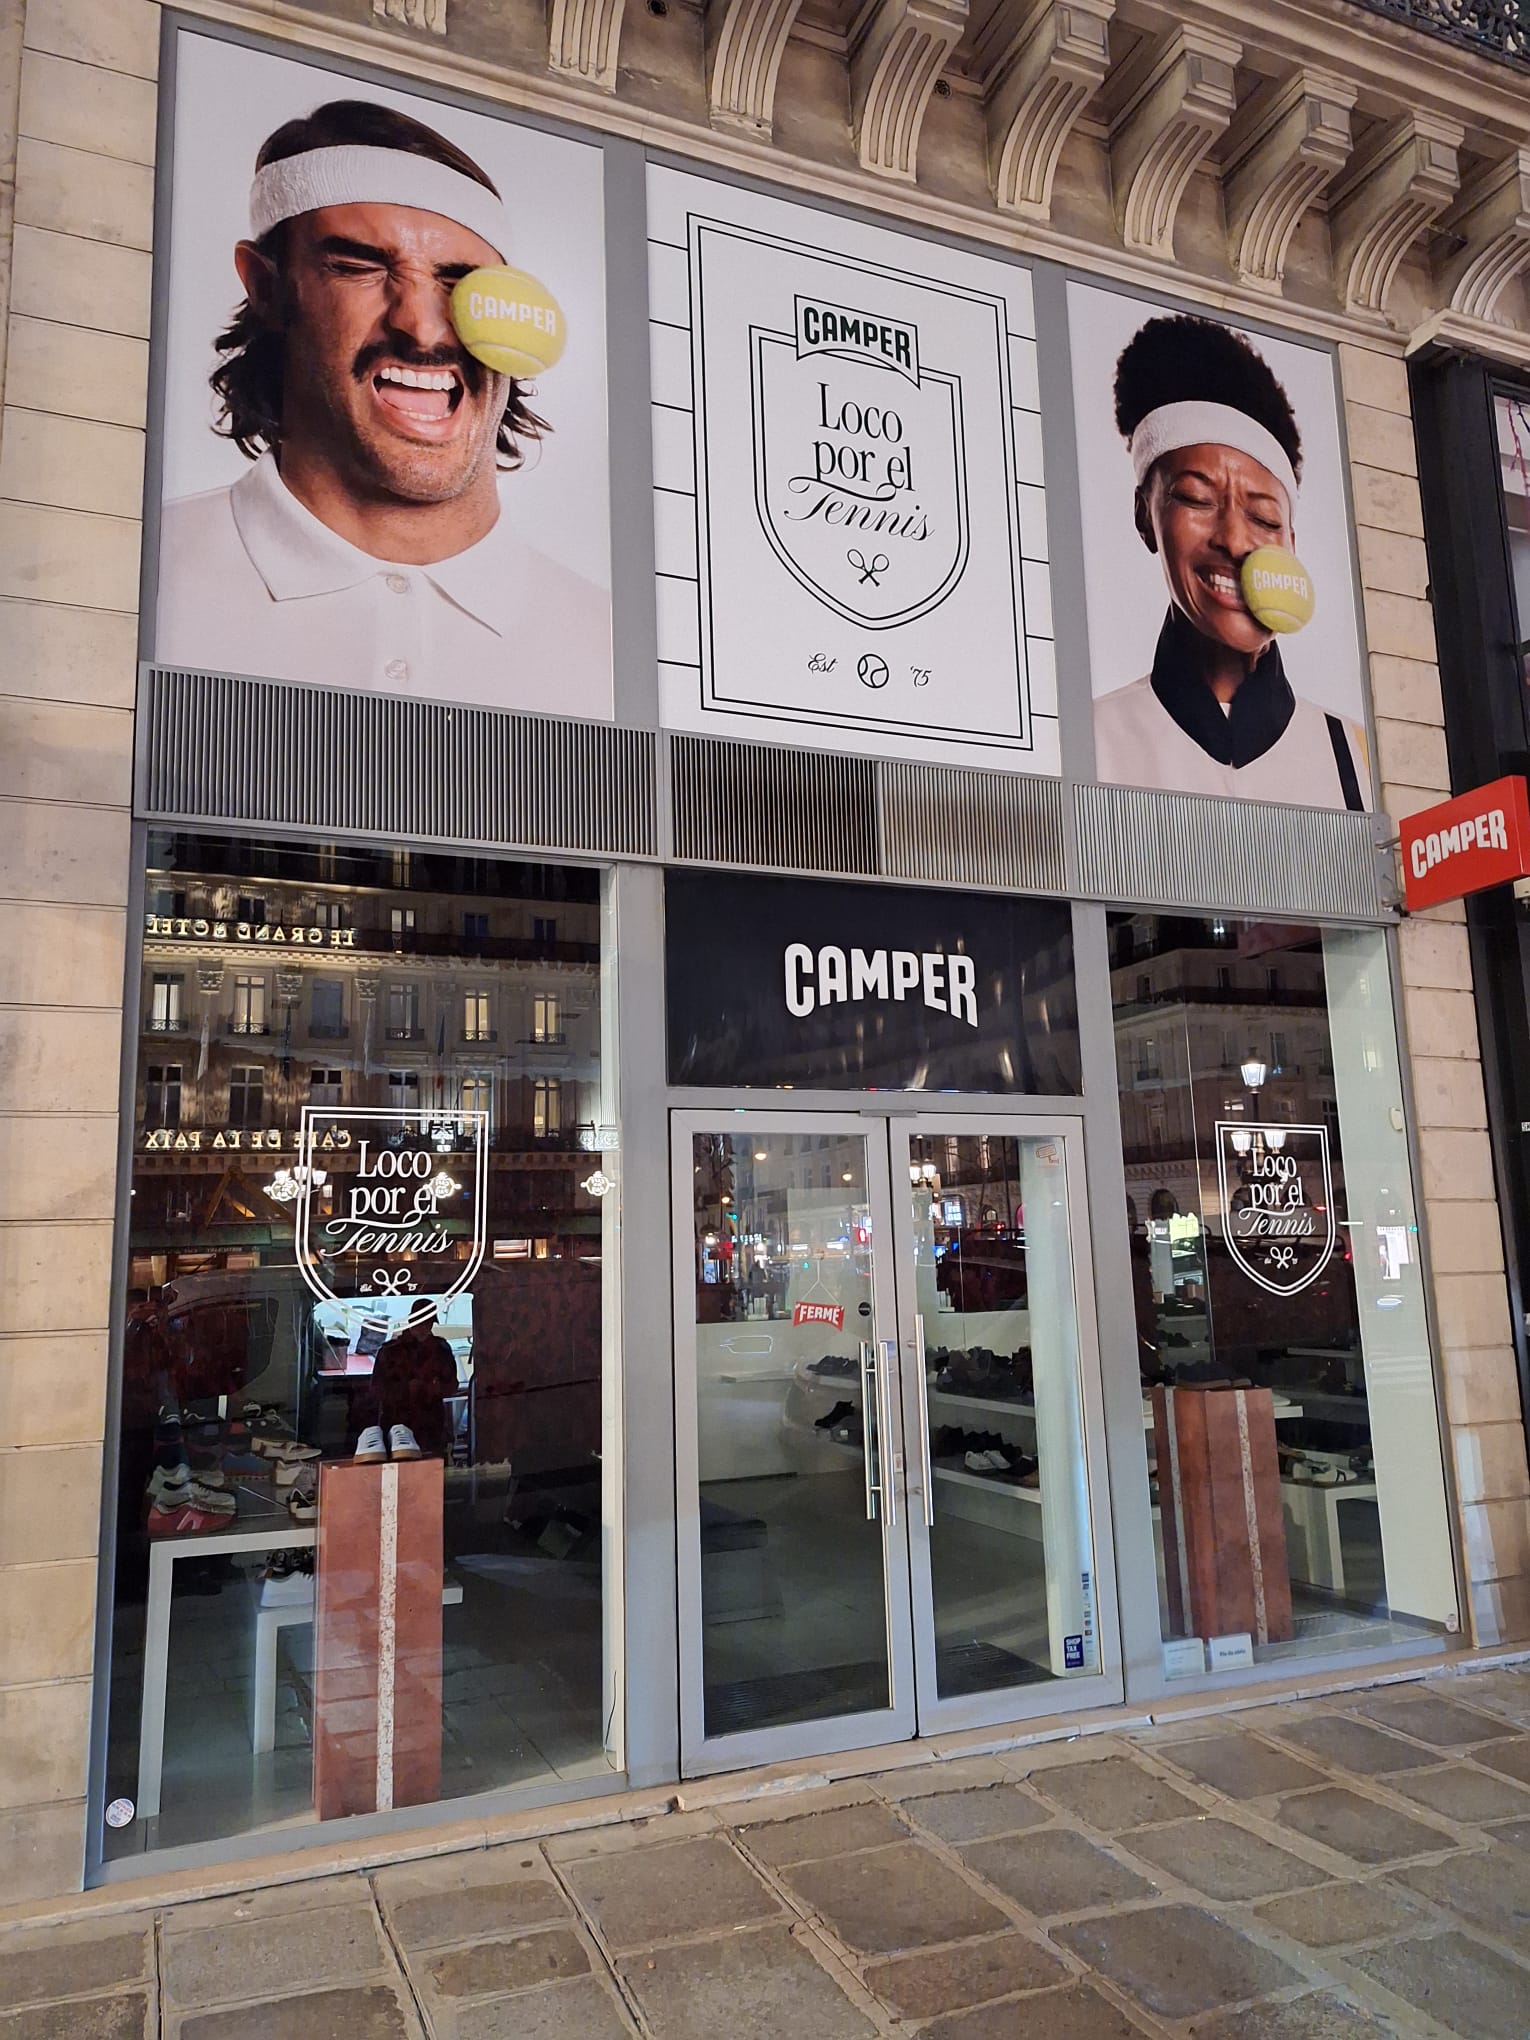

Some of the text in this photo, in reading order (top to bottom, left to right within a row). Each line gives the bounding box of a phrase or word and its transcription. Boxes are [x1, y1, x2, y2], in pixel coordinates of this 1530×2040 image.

[469, 291, 556, 337] CAMPER
[803, 306, 911, 370] CAMPER
[816, 382, 903, 443] Loco
[812, 440, 916, 493] por el
[783, 476, 936, 541] Tennis
[1252, 567, 1309, 600] CAMPER
[807, 652, 838, 674] Est
[1410, 808, 1509, 879] CAMPER
[784, 942, 979, 1028] CAMPER
[356, 1140, 432, 1178] Loco
[1251, 1147, 1297, 1178] Loco
[350, 1186, 406, 1220] por
[1249, 1176, 1305, 1209] por el
[319, 1217, 454, 1257] Tennis
[1237, 1207, 1317, 1237] Tennis
